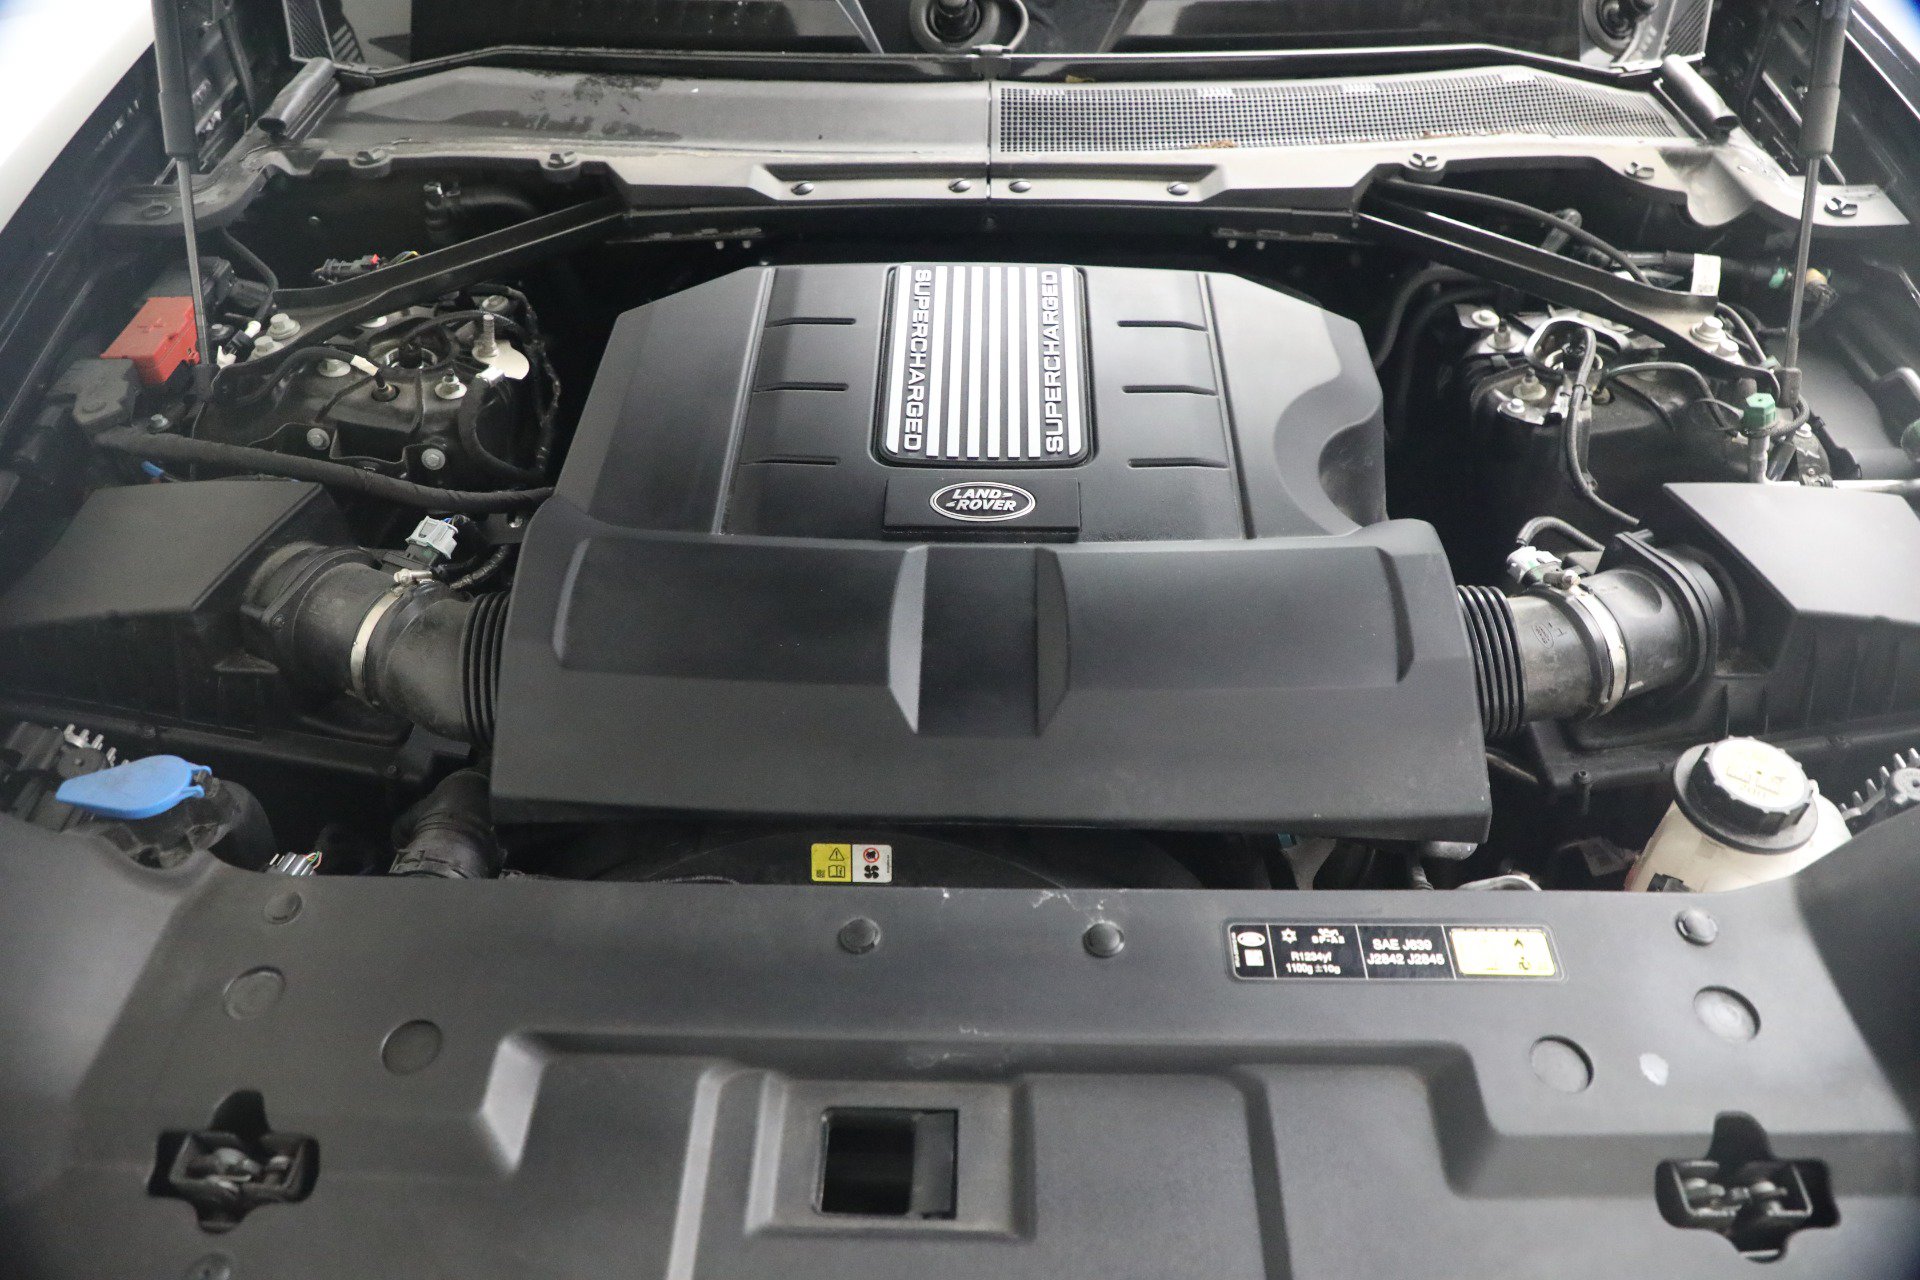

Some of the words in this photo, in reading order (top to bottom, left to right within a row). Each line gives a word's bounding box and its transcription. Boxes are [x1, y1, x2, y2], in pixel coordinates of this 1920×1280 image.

[903, 268, 932, 452] SUPERCHARGED
[1041, 270, 1065, 454] SUPERCHARGED
[952, 488, 1003, 499] LAND
[955, 499, 1017, 511] ROVER
[1372, 938, 1400, 951] SAE
